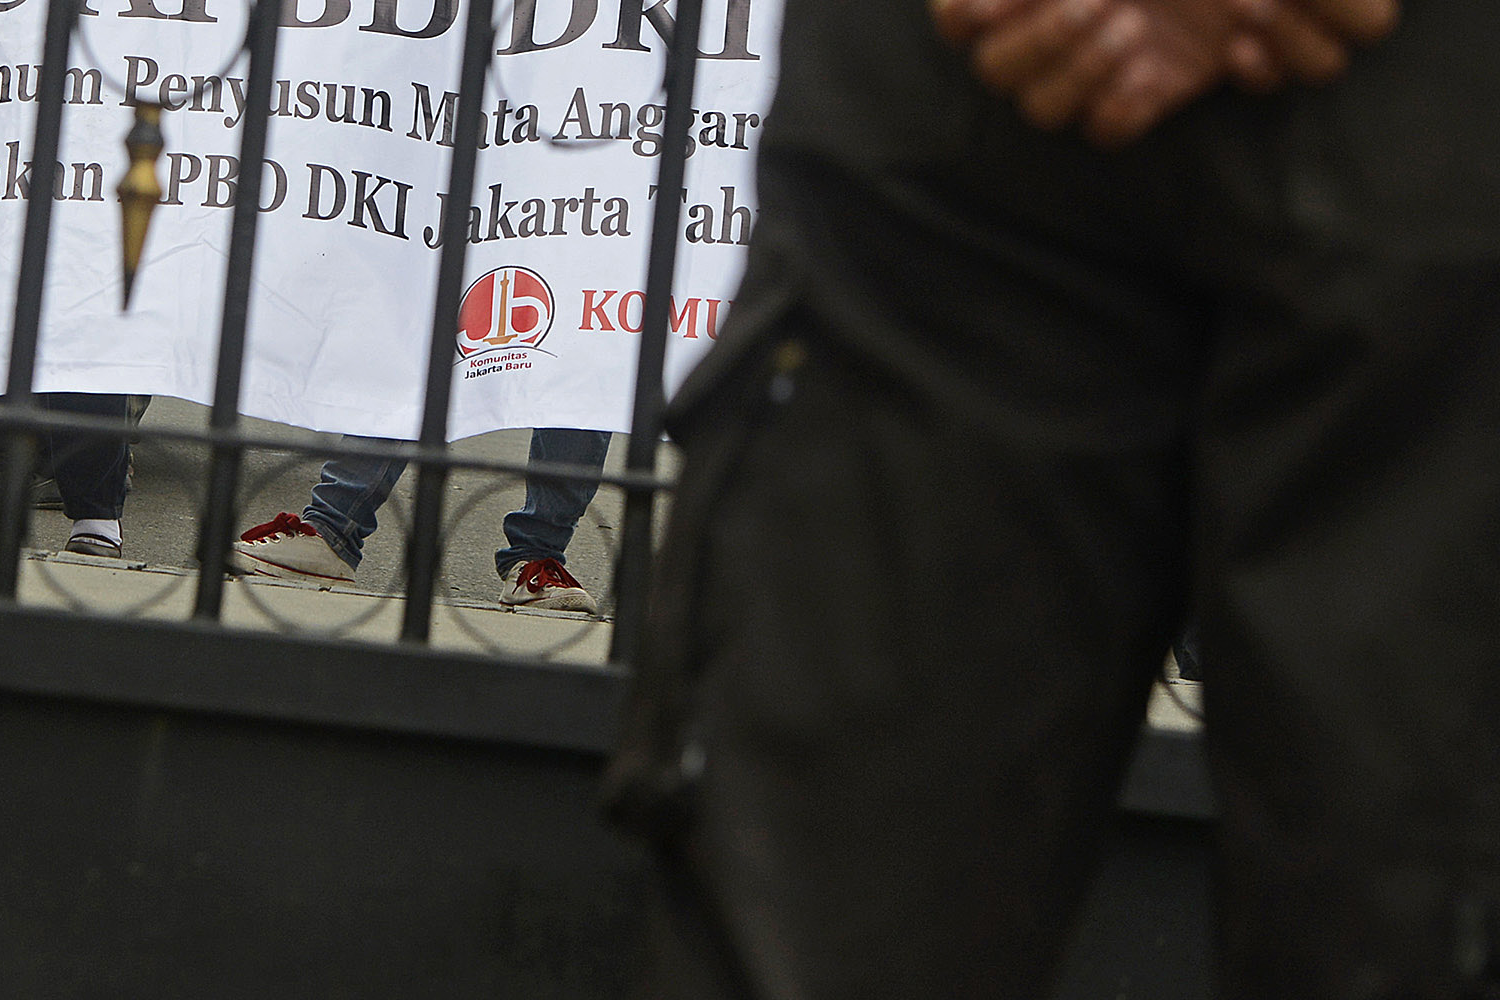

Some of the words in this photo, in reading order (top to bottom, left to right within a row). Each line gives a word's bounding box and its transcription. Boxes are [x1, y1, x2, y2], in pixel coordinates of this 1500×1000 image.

[118, 55, 393, 132] Penyusun
[552, 87, 765, 159] Angar
[117, 152, 288, 213] PBD
[302, 162, 413, 241] DKI
[648, 185, 760, 246] ah
[465, 365, 503, 379] Jakarta
[505, 362, 532, 371] Baru
[470, 352, 528, 368] Komunitas
